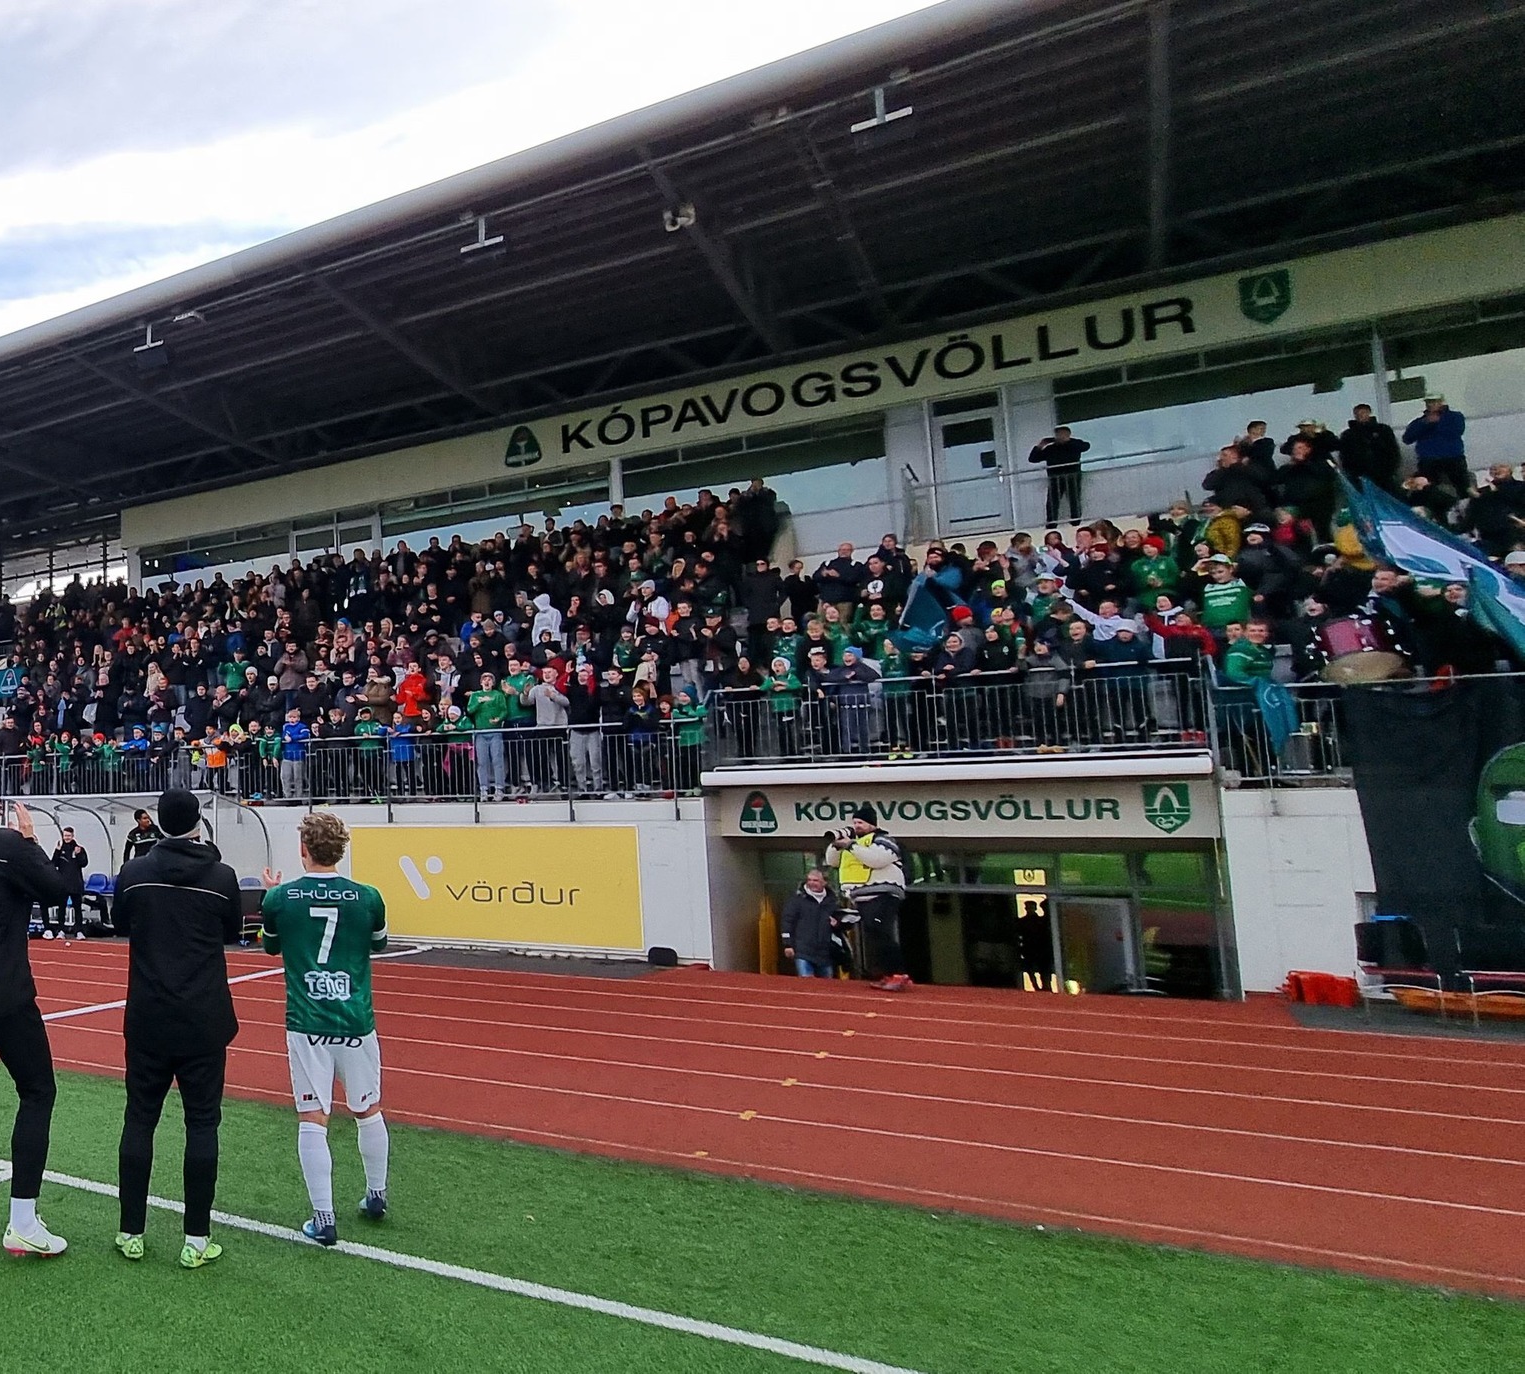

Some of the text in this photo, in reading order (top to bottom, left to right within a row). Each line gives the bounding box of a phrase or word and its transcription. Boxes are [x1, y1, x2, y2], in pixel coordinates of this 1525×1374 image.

[561, 297, 1196, 454] KÓPAVOGSVÖLLUR
[795, 794, 1121, 821] KÓPVOGSVÖLLUR
[446, 881, 580, 905] vörður
[309, 906, 338, 964] 7
